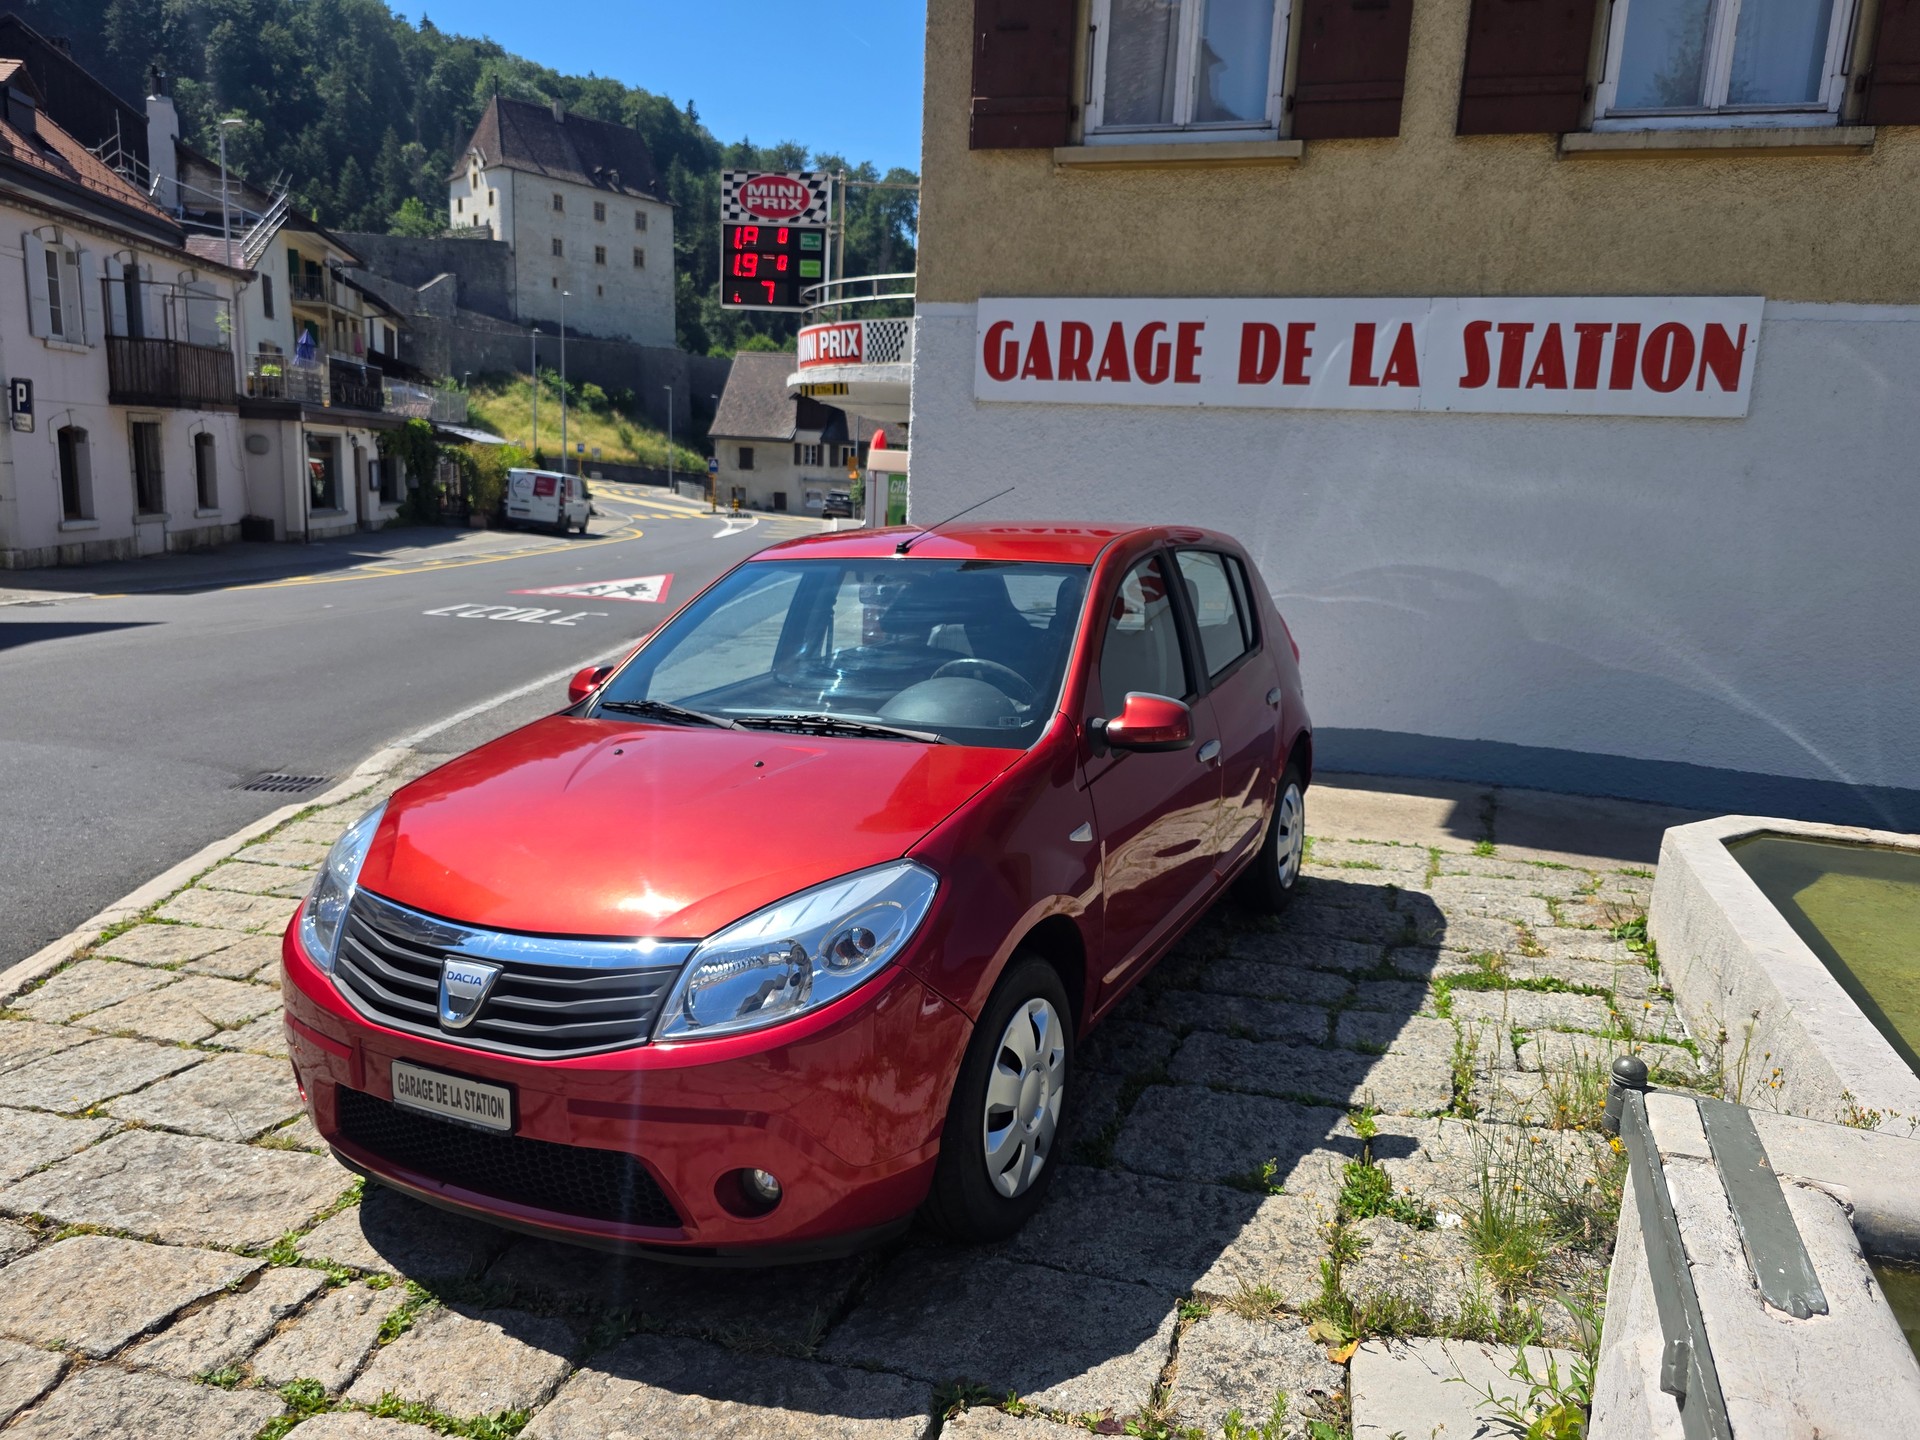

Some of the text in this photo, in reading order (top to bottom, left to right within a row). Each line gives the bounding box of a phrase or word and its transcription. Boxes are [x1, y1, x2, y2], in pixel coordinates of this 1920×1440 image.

[747, 184, 803, 198] MINI
[747, 197, 803, 211] PRIX
[819, 328, 860, 359] PRIX
[983, 320, 1746, 392] GARAGE DE LA STATION
[16, 383, 26, 411] P
[446, 971, 482, 986] DACIA
[398, 1072, 505, 1119] GARAGE DE LA STATION
